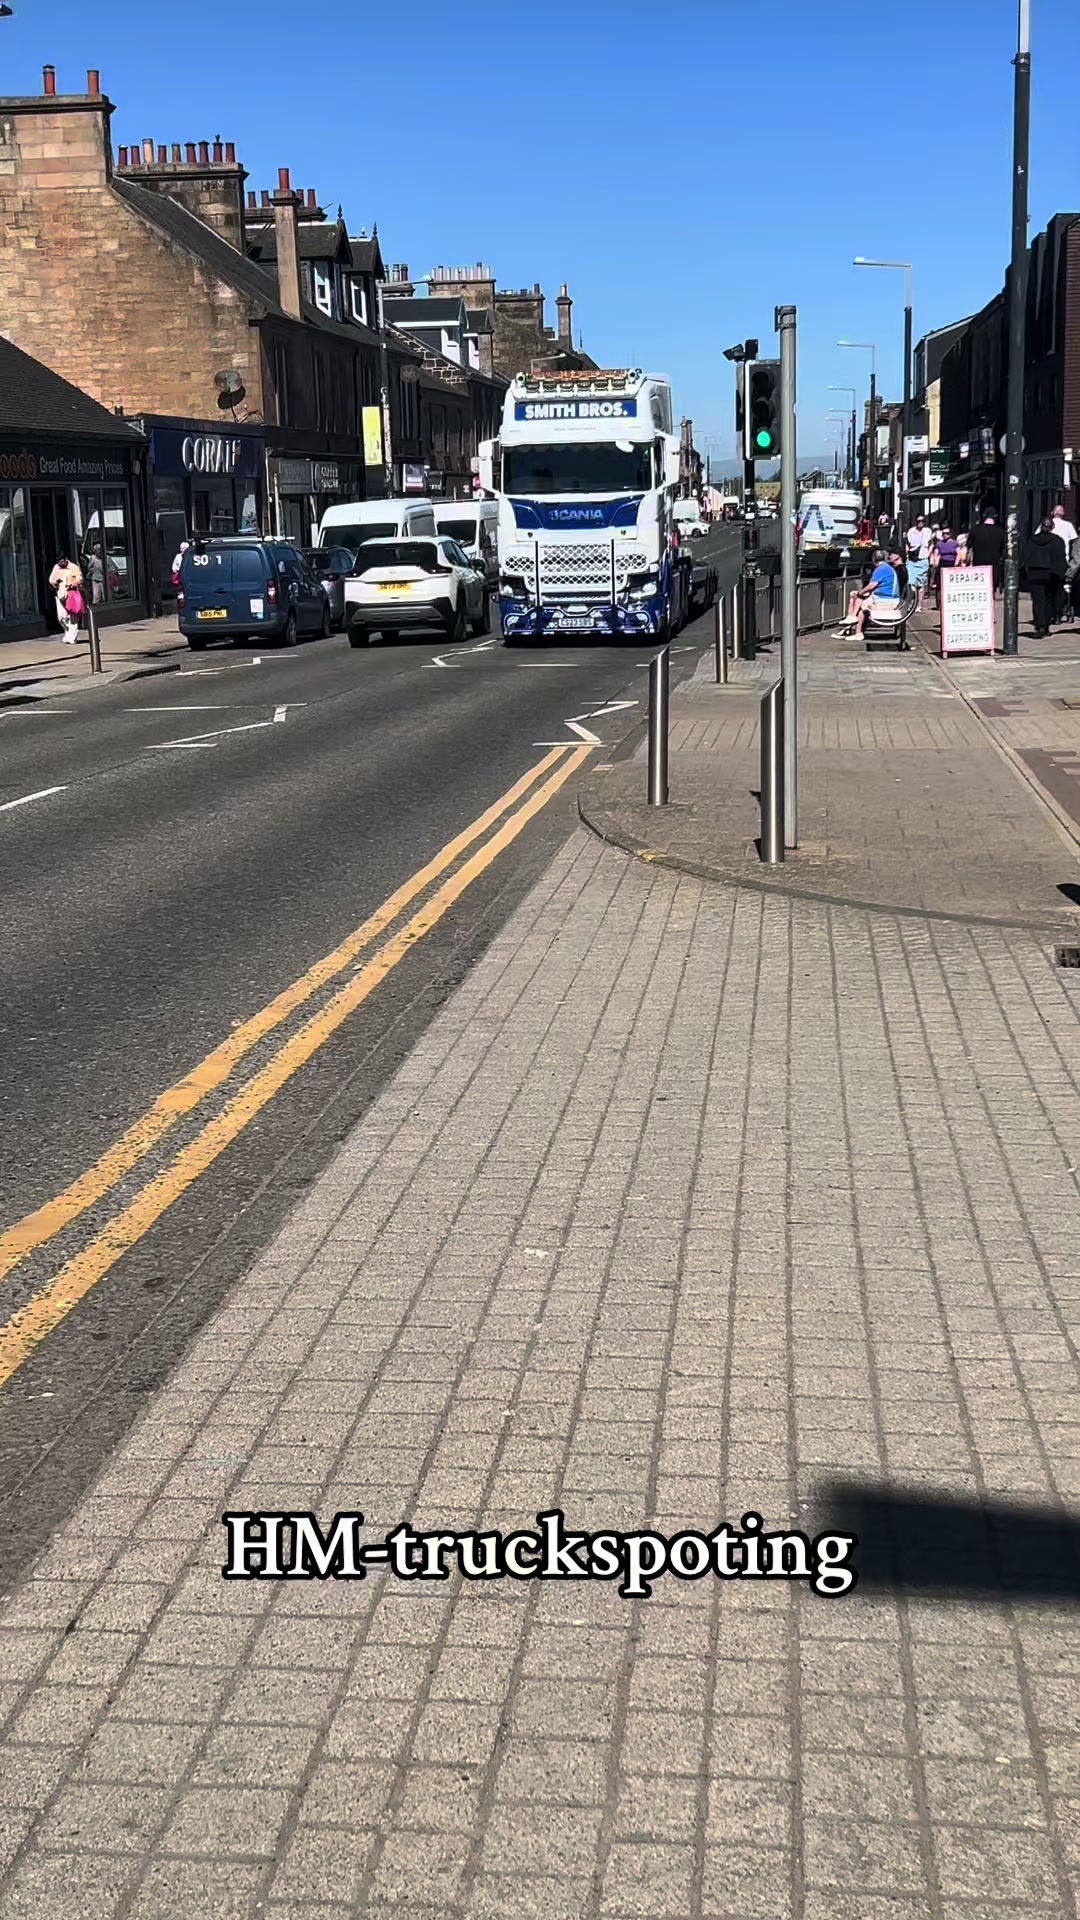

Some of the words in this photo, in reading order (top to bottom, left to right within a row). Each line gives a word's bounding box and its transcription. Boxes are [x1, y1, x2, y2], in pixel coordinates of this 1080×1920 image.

[524, 403, 576, 419] SMITH
[578, 402, 629, 417] BROS.
[39, 456, 59, 474] Great
[59, 457, 77, 474] Food
[77, 458, 105, 480] Amazing
[104, 458, 124, 476] Prices
[548, 508, 605, 521] SCANIA
[948, 572, 985, 584] REPAIRS
[946, 592, 989, 604] BATTERIES
[952, 612, 985, 624] STRAPS
